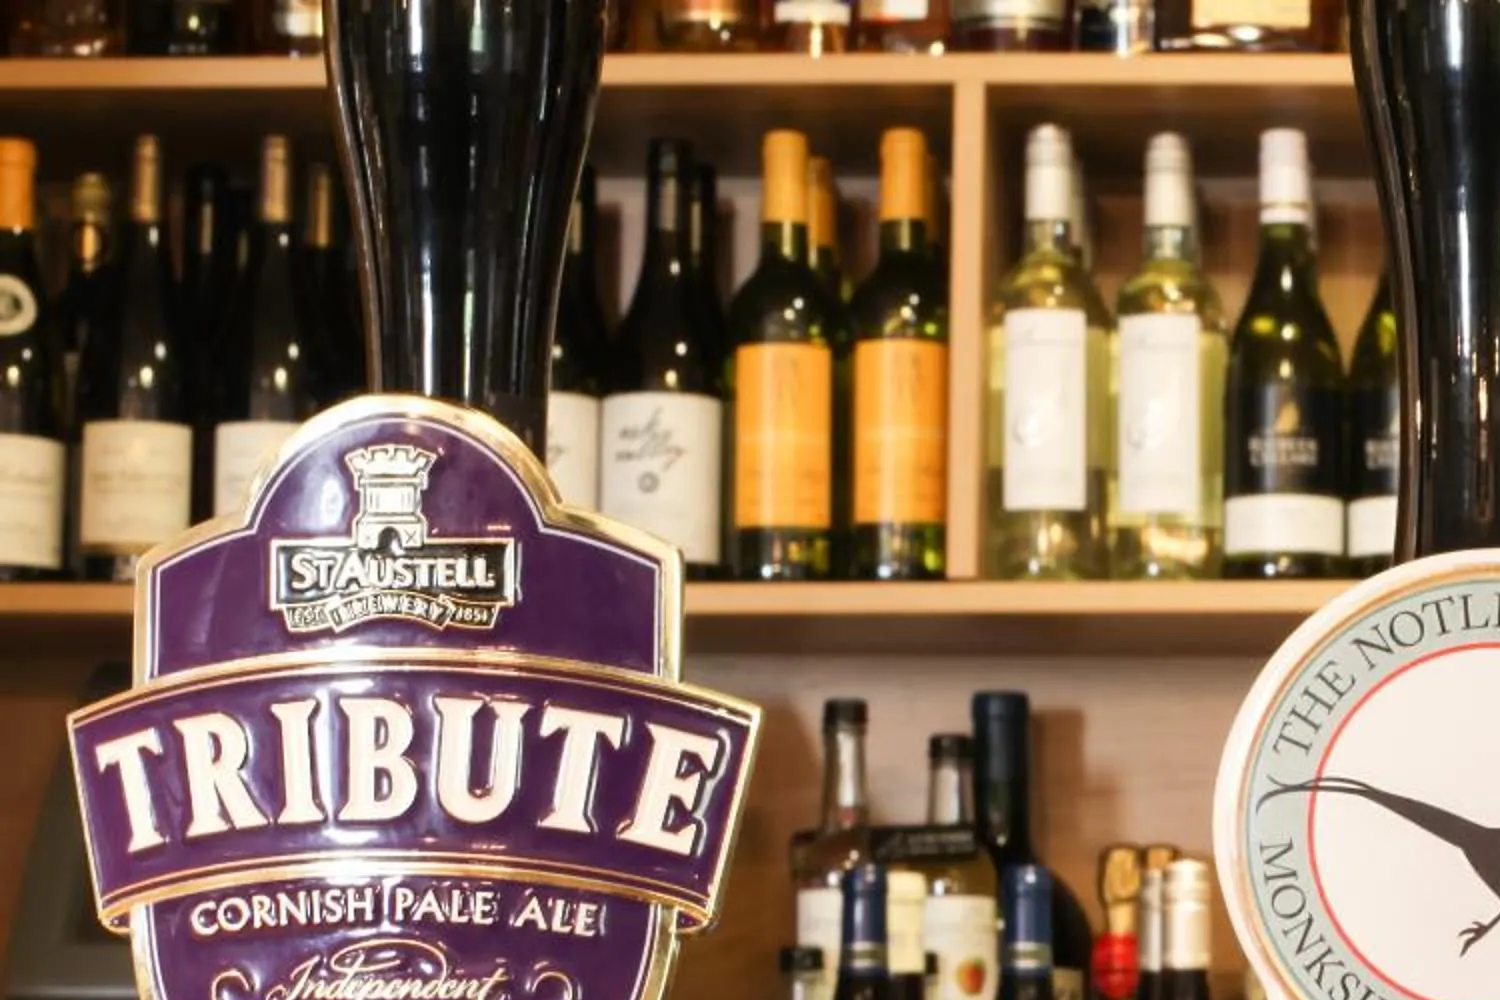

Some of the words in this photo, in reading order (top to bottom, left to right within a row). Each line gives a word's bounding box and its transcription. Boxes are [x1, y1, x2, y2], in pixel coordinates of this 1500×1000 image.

[336, 552, 496, 590] AUSTELL
[1273, 660, 1355, 758] THE
[96, 696, 722, 857] TRIBUTE
[190, 888, 373, 935] CORNISH
[395, 888, 494, 926] PALE
[515, 894, 600, 937] ALE
